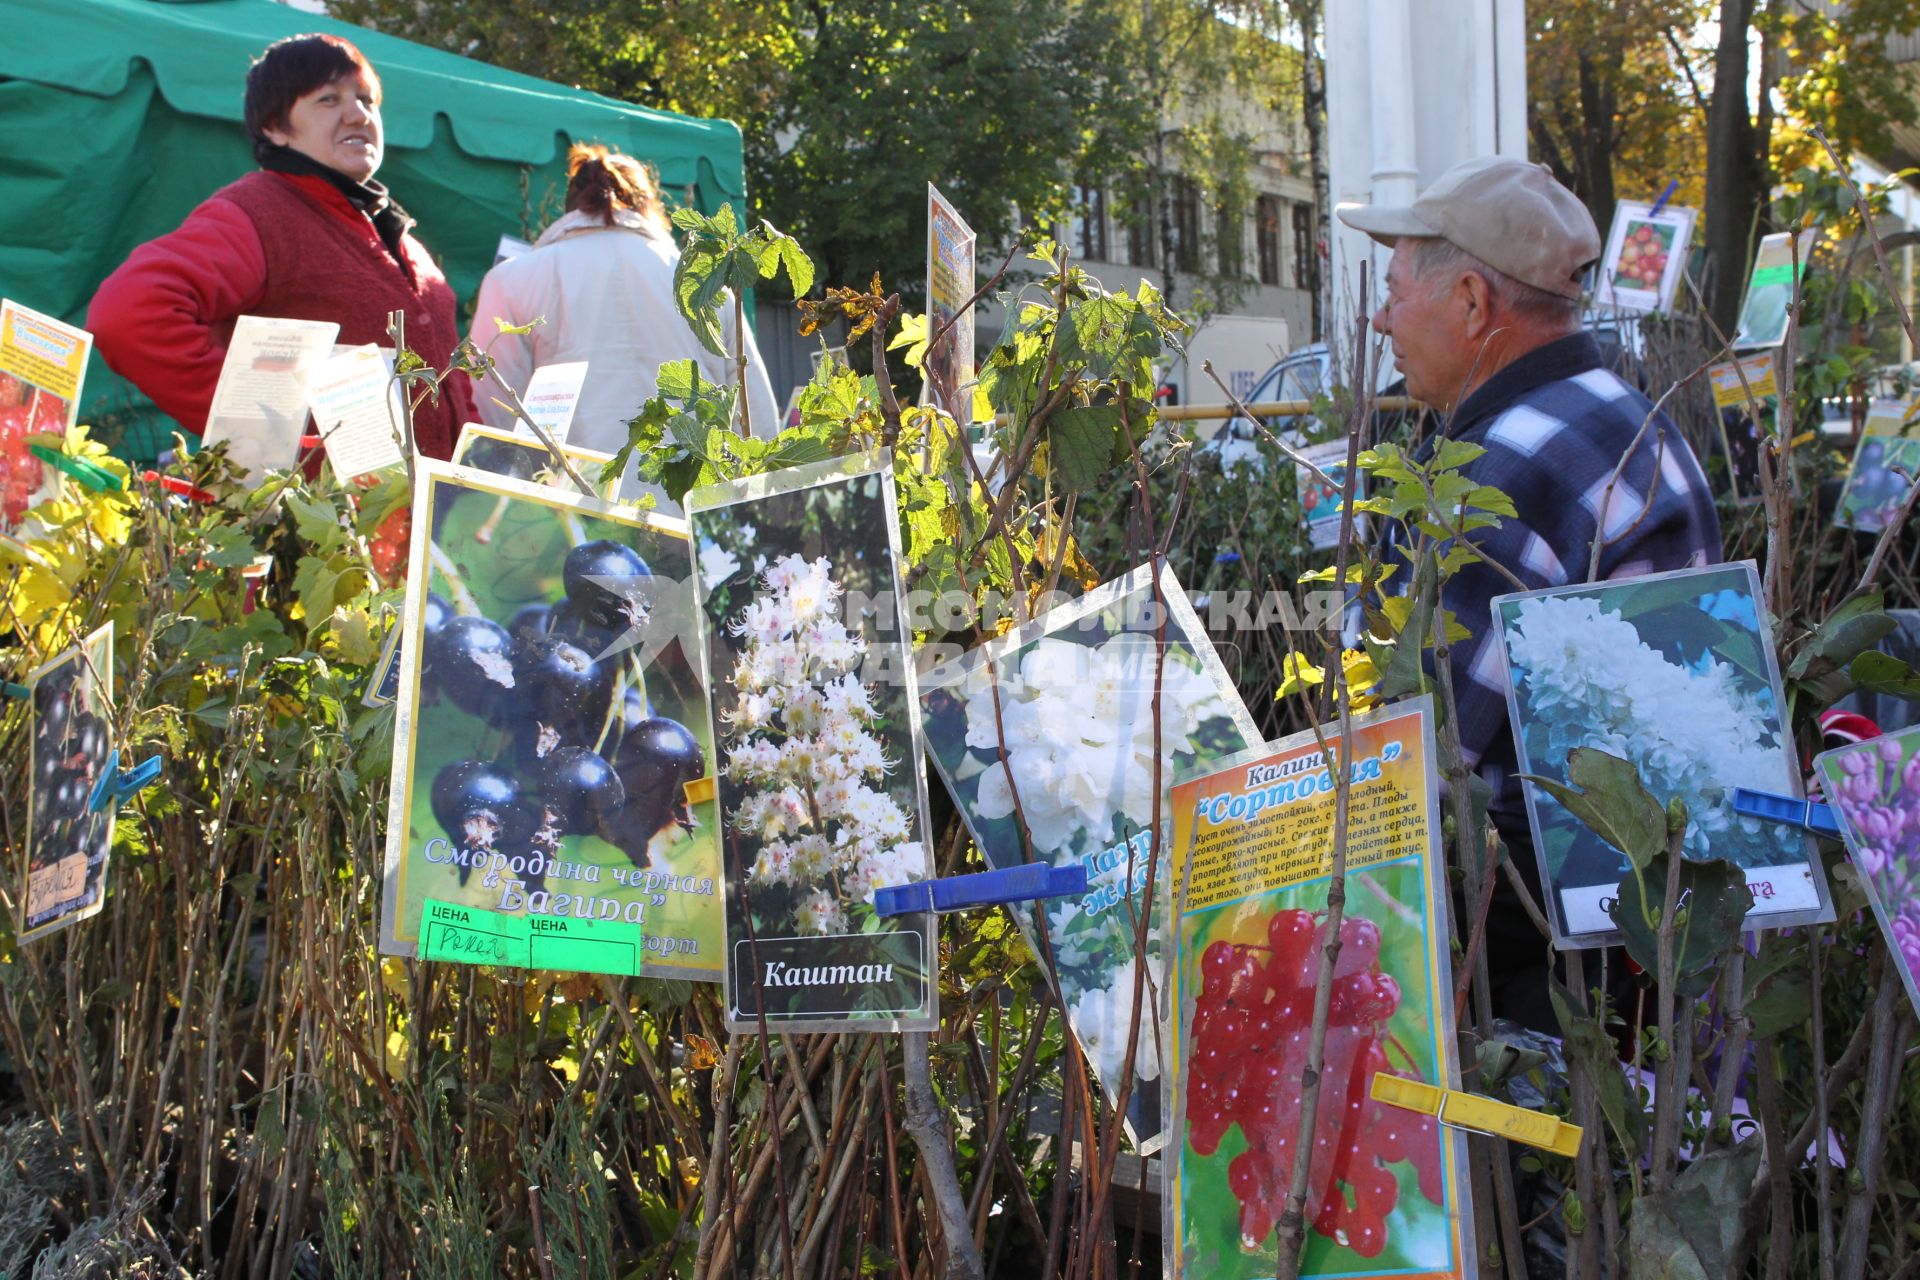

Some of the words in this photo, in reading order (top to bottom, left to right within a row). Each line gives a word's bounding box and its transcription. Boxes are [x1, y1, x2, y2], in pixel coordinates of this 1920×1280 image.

[1373, 792, 1409, 808] Плоды
[1192, 859, 1258, 883] употребляют
[1260, 853, 1278, 865] при
[1384, 815, 1425, 831] сердца,
[1195, 831, 1219, 845] Куст
[1220, 825, 1246, 837] очень
[1221, 837, 1289, 862] ярко-красные.
[1379, 803, 1417, 817] также
[424, 837, 600, 882] Смородина
[611, 867, 714, 895] черная
[1186, 893, 1214, 908] Кроме
[1216, 889, 1242, 901] того,
[1244, 881, 1262, 893] они
[1264, 868, 1320, 887] повышают
[1386, 843, 1424, 857] тонус.
[1206, 879, 1226, 891] язве
[1228, 867, 1272, 885] желудка,
[1274, 856, 1317, 874] нервных
[1405, 831, 1412, 840] и
[432, 906, 470, 923] ЦЕНА
[531, 919, 568, 932] ЦЕНА
[763, 962, 894, 987] Каштан
